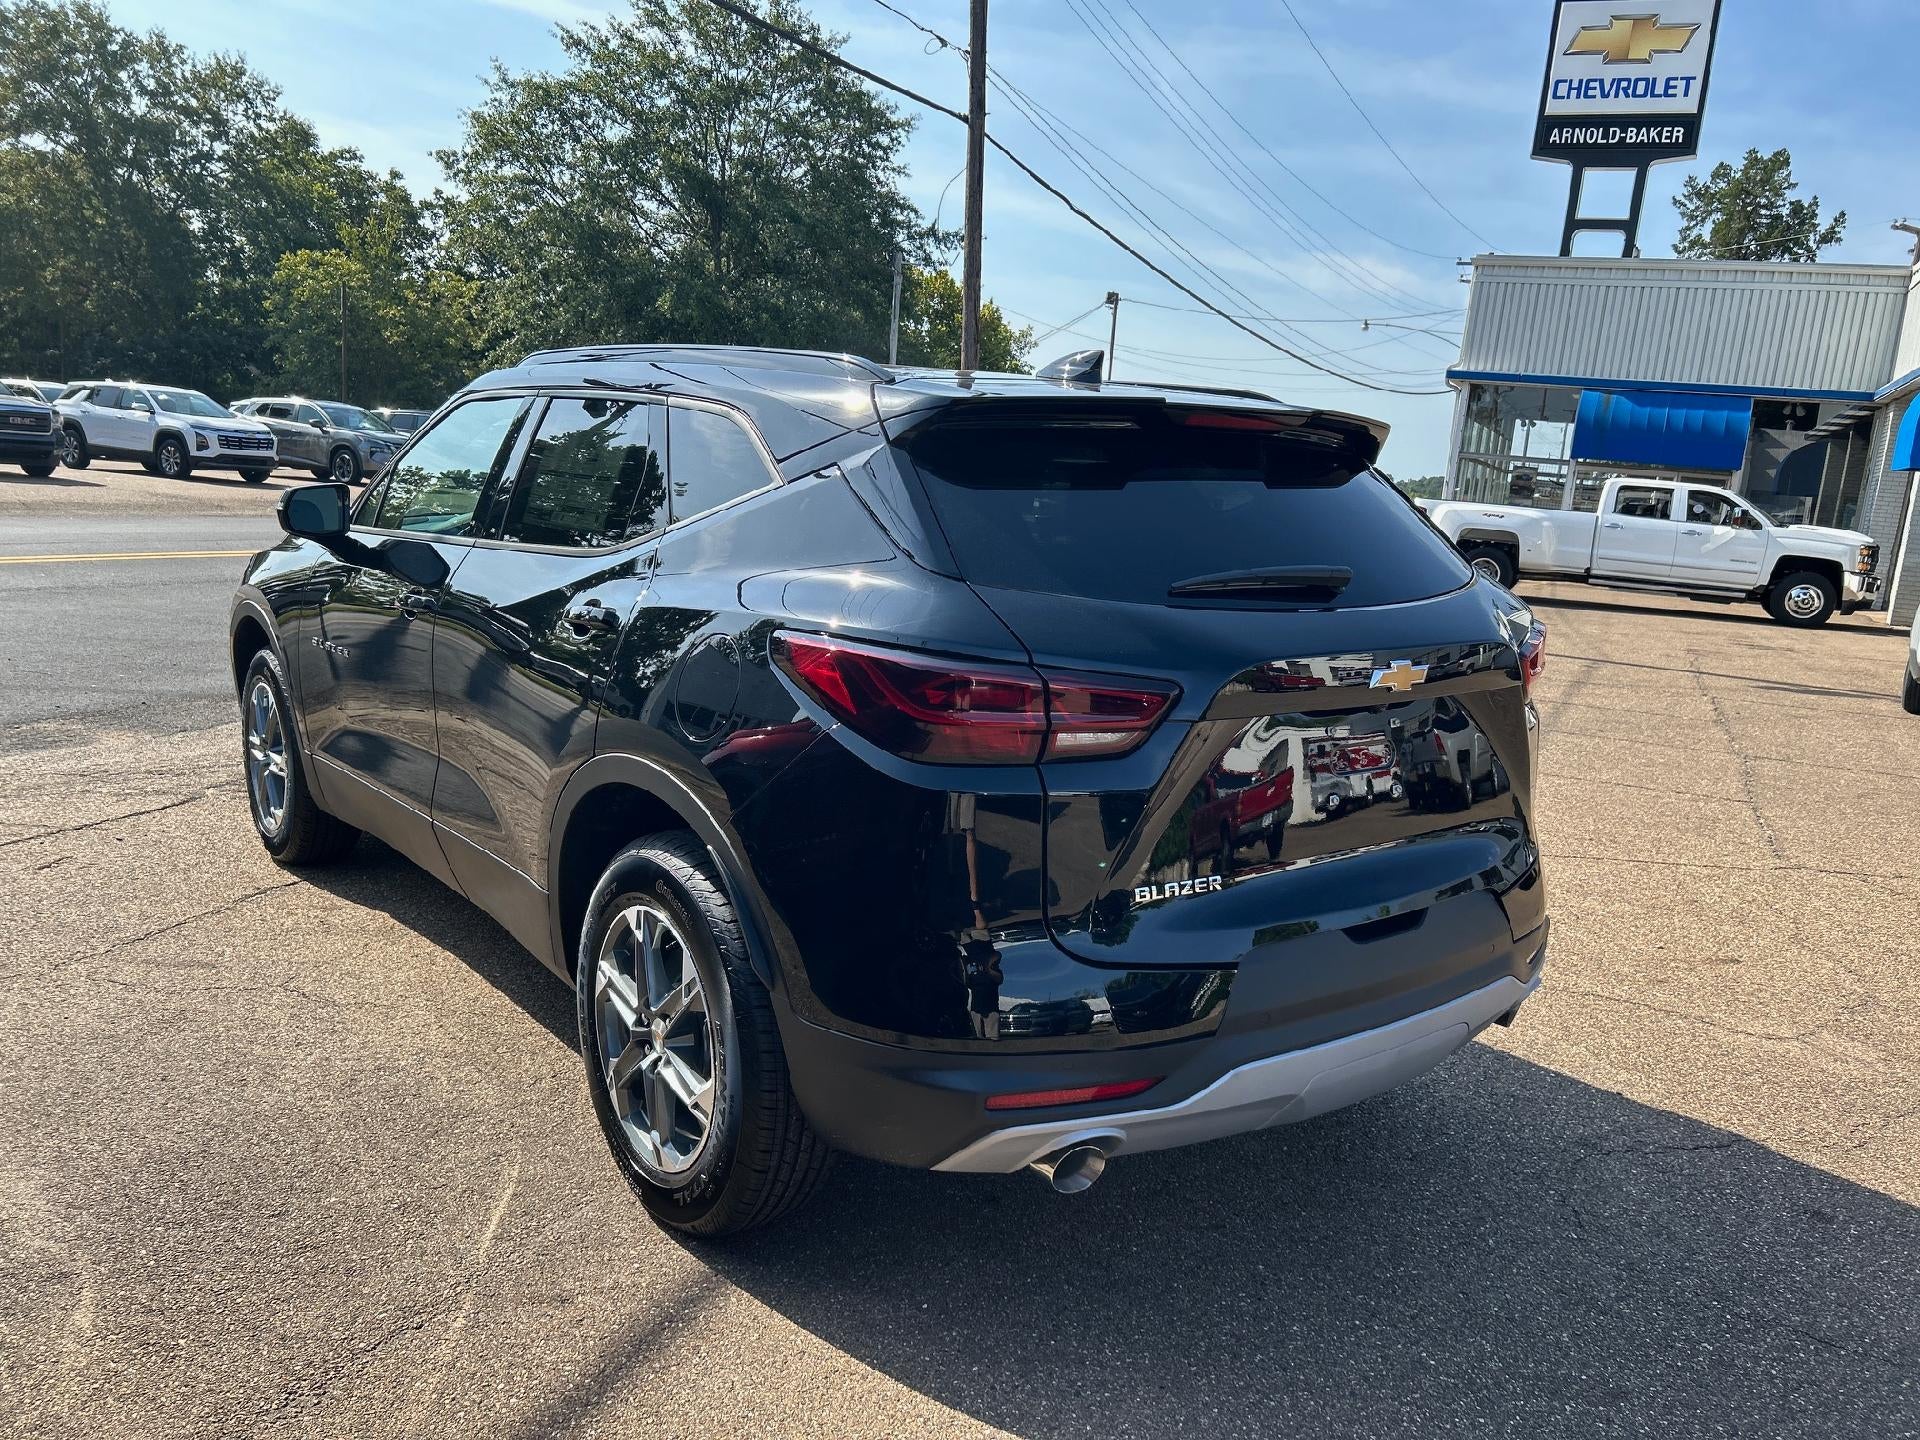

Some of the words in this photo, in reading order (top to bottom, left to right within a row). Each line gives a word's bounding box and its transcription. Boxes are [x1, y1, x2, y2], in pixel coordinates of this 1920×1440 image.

[1551, 76, 1697, 100] CHEVROLET
[1549, 126, 1685, 144] ARNOLD-BAKER
[1134, 875, 1222, 902] BLAZER
